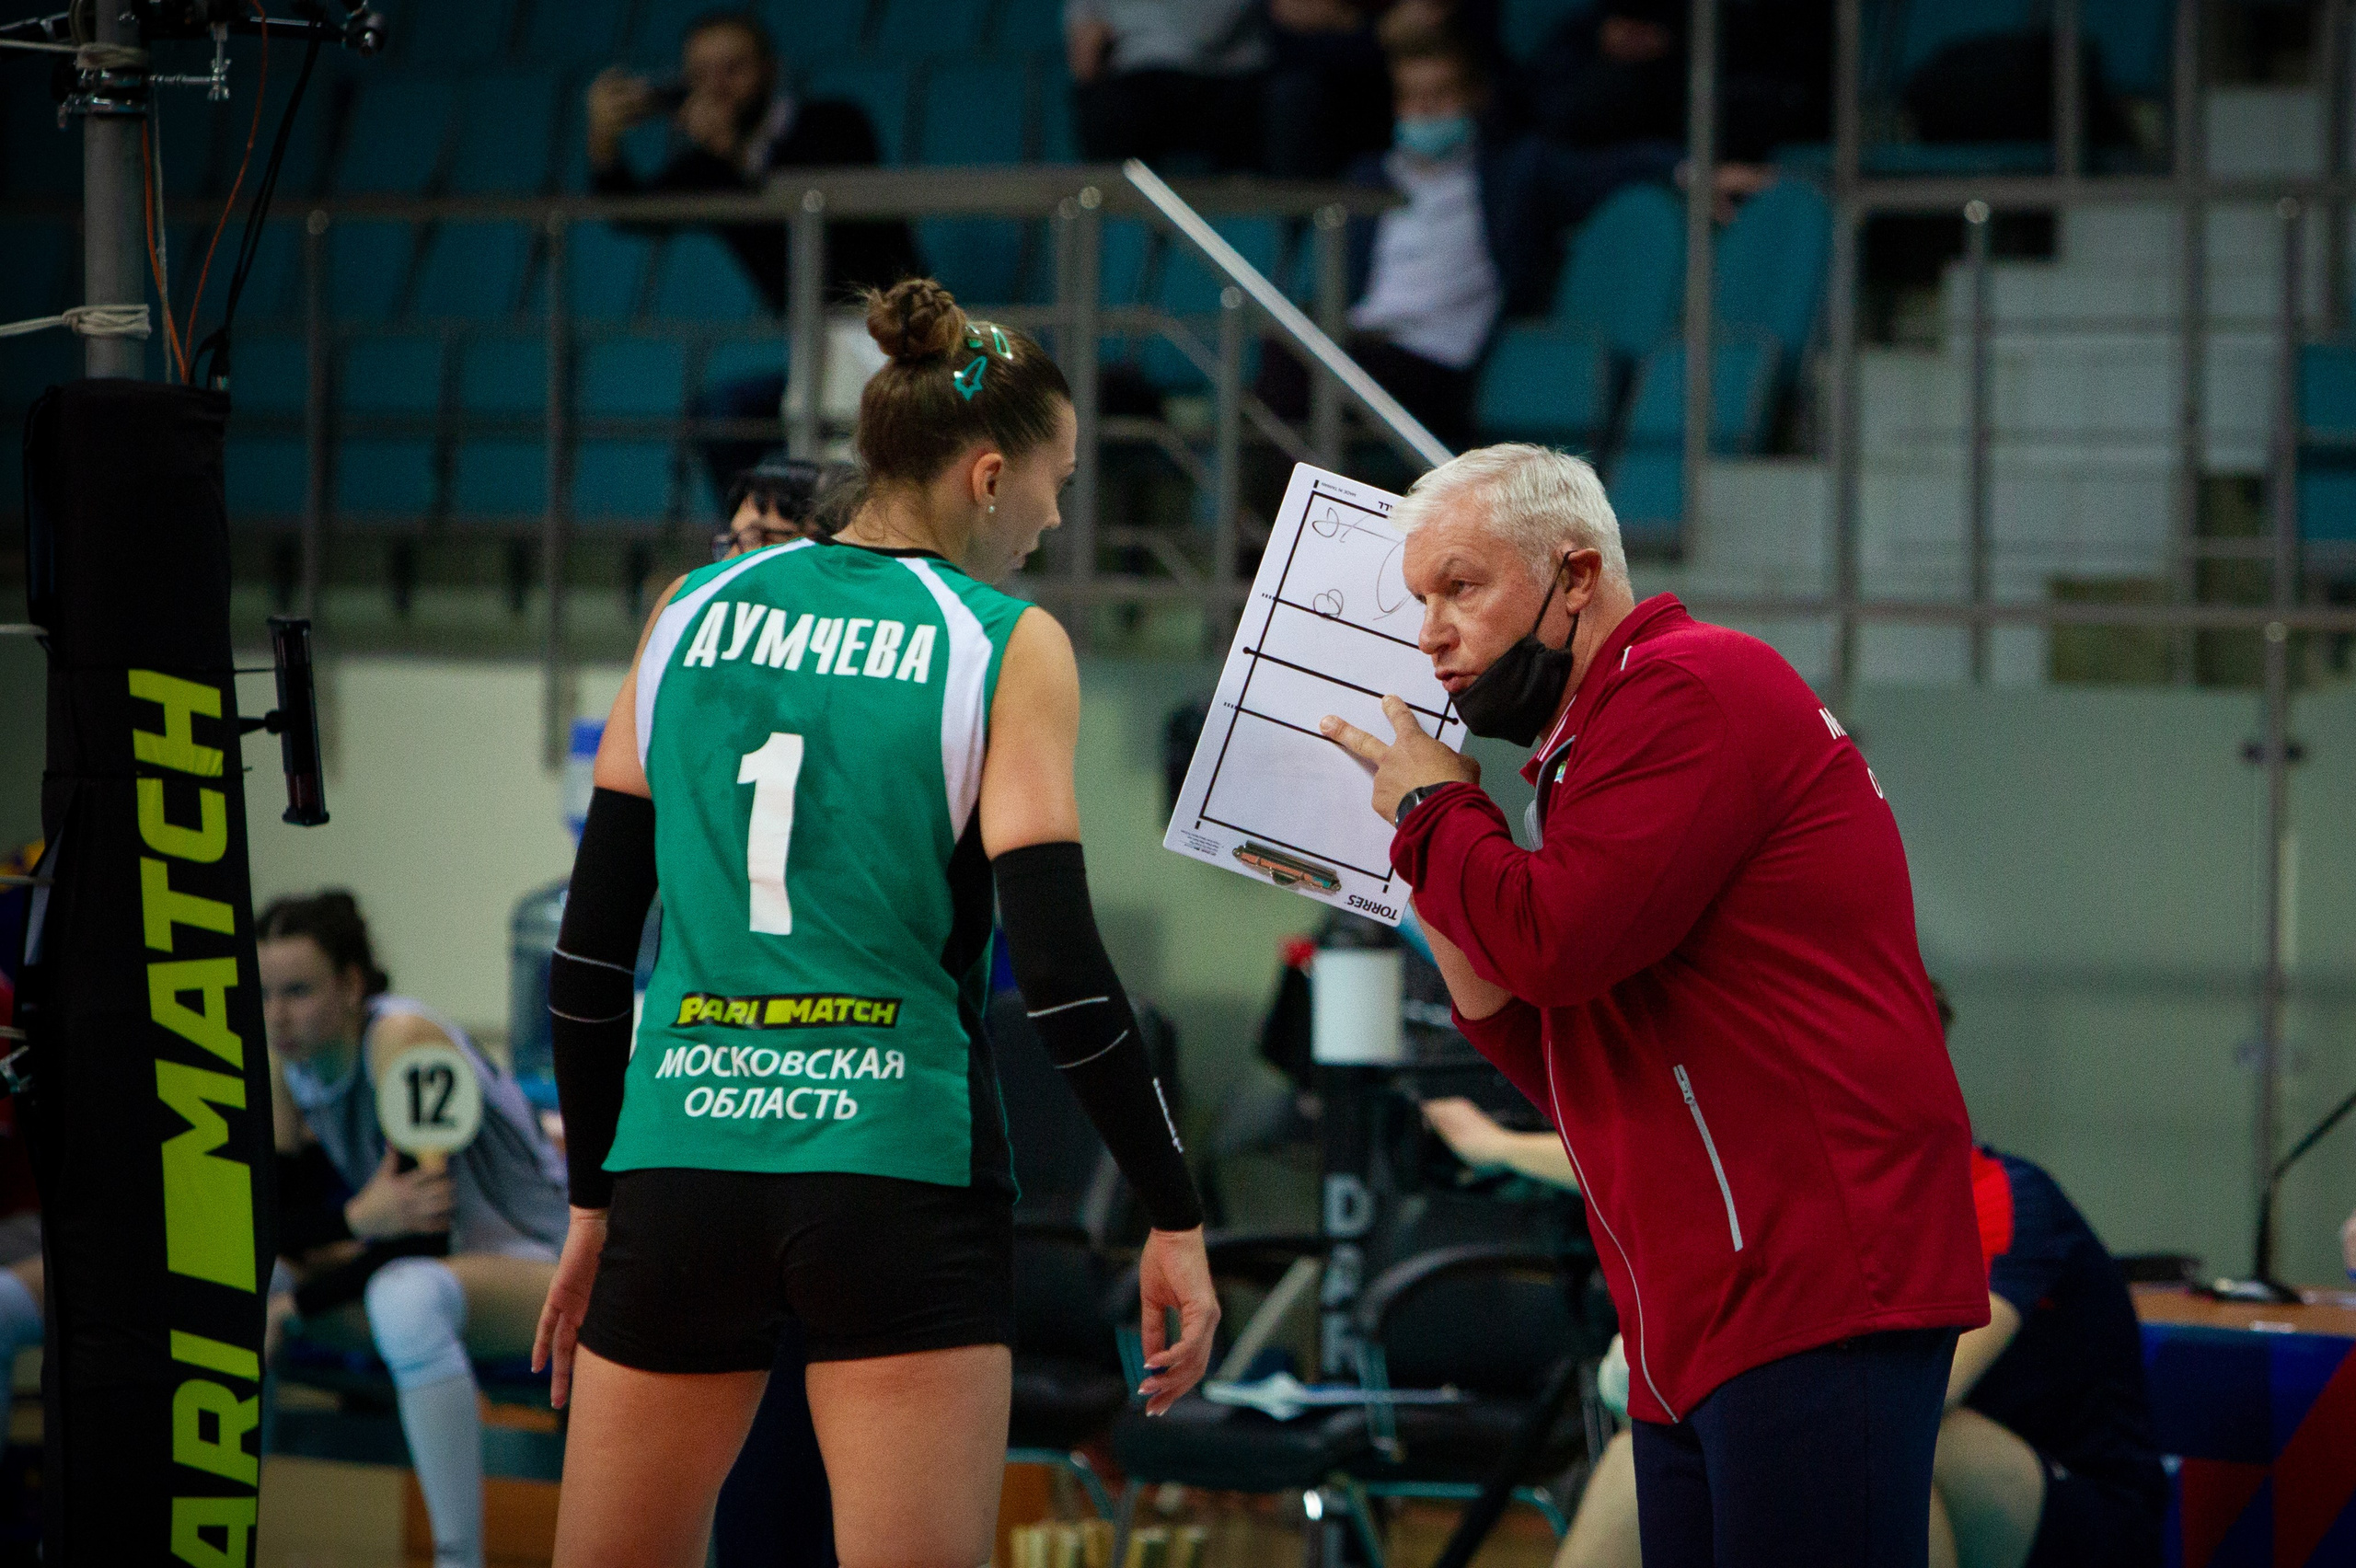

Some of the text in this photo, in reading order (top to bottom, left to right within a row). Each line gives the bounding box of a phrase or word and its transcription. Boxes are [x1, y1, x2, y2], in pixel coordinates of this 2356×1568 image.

[683, 601, 937, 684] ДУМЧЕВА
[736, 732, 803, 936] 1
[1346, 894, 1398, 920] TORRES
[128, 669, 258, 1294] MATCH
[677, 997, 895, 1026] PARI MATCH
[655, 1043, 905, 1079] МОСКОВСКАЯ
[405, 1063, 456, 1127] 12
[685, 1087, 858, 1121] ОБЛАСТЬ
